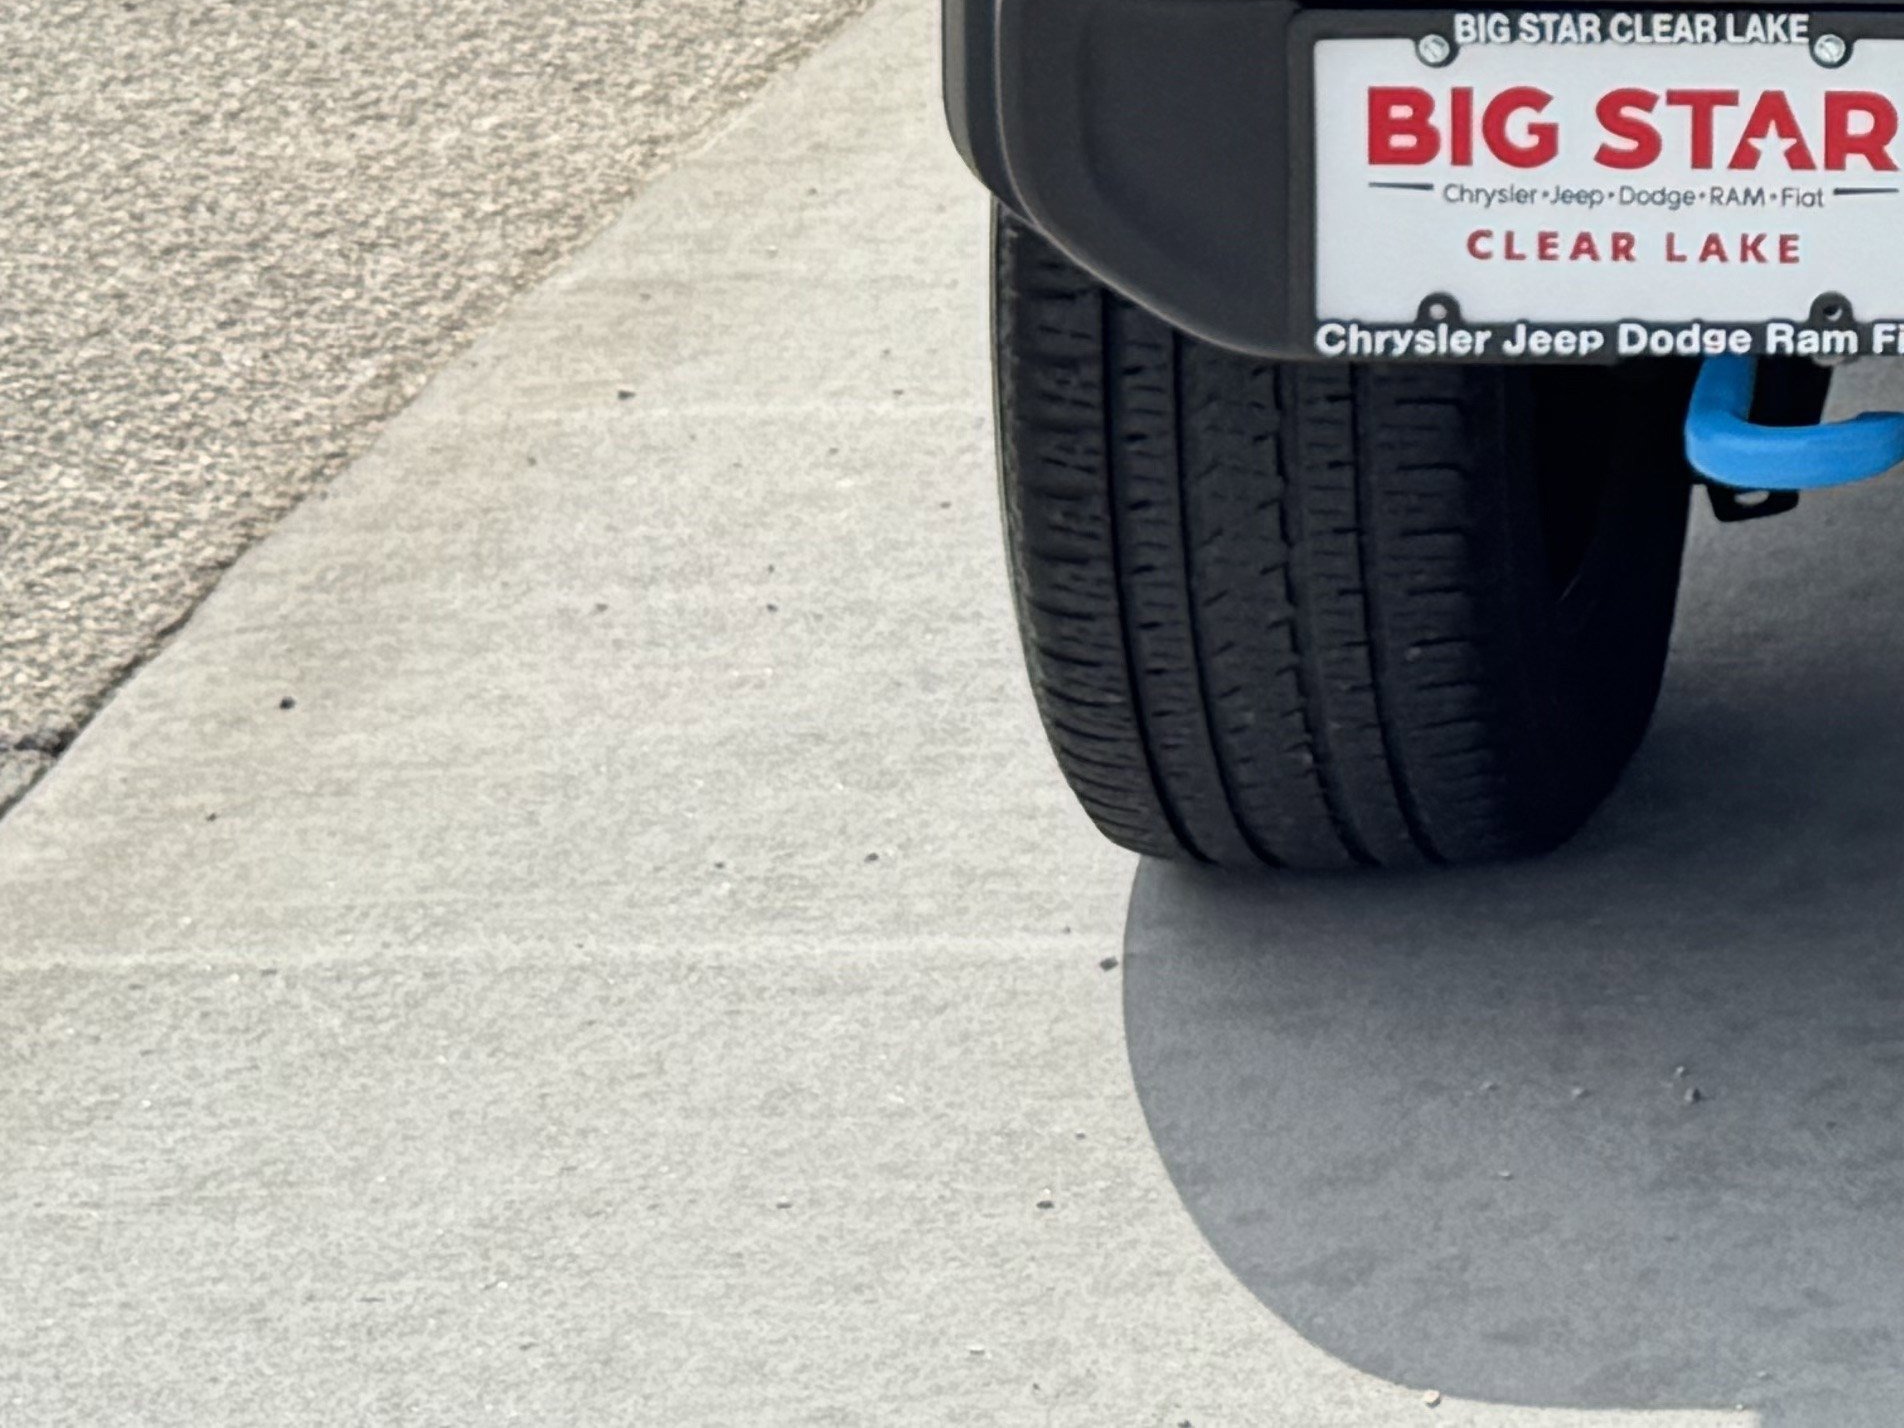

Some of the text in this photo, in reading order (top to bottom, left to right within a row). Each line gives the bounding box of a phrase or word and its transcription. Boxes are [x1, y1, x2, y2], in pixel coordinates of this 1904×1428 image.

[1454, 12, 1811, 44] BIG STAR CLEAR LAKE
[1366, 85, 1901, 172] BIG STAR
[1465, 228, 1804, 265] CLEAR LAKE
[1314, 321, 1493, 358] Chrysler
[1501, 322, 1605, 358] Jeep
[1617, 321, 1753, 358] Dodge
[1764, 321, 1859, 357] Ram
